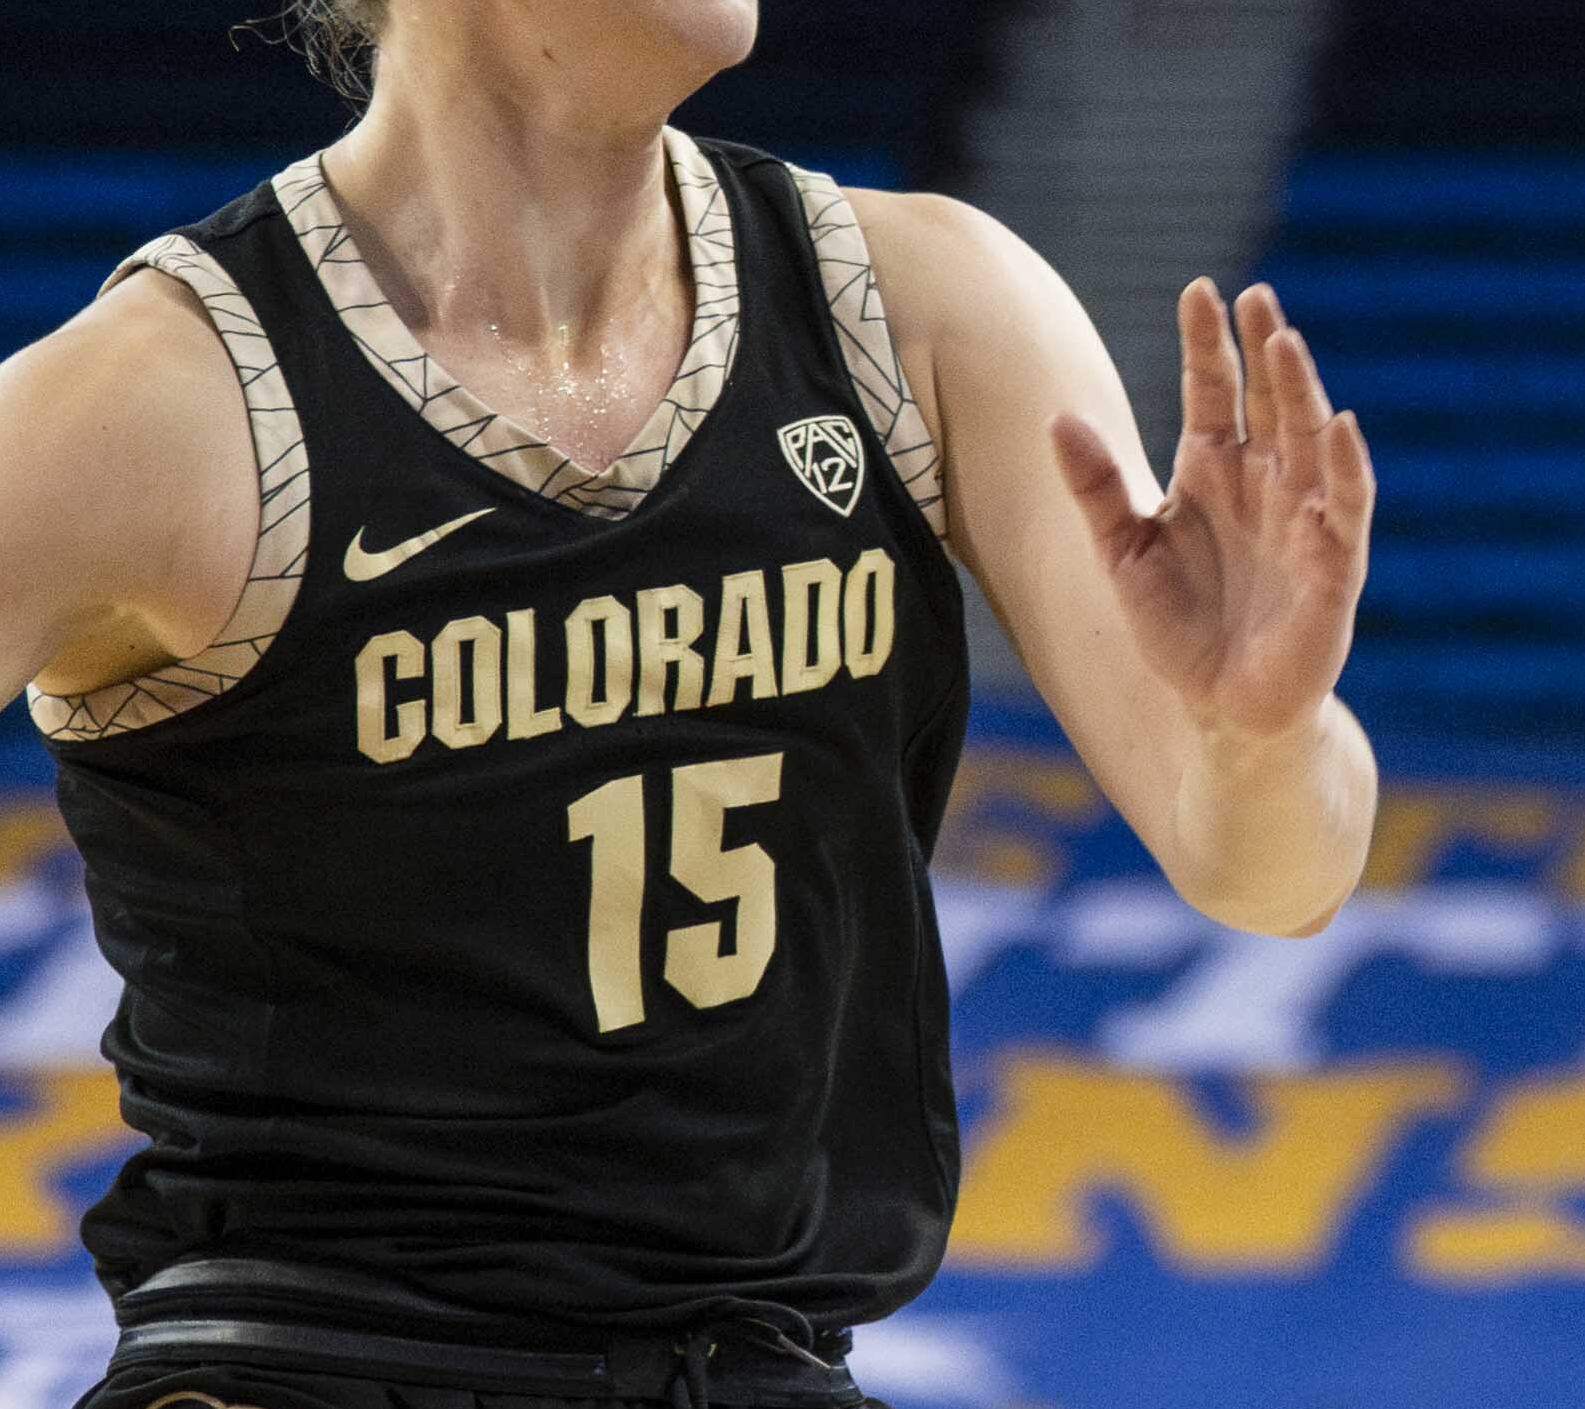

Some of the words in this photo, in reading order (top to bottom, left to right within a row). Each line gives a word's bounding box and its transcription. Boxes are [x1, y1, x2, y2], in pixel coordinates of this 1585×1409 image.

[785, 421, 858, 479] PAC
[811, 457, 854, 494] 12
[354, 548, 895, 765] COLORADO
[566, 751, 784, 1034] 15
